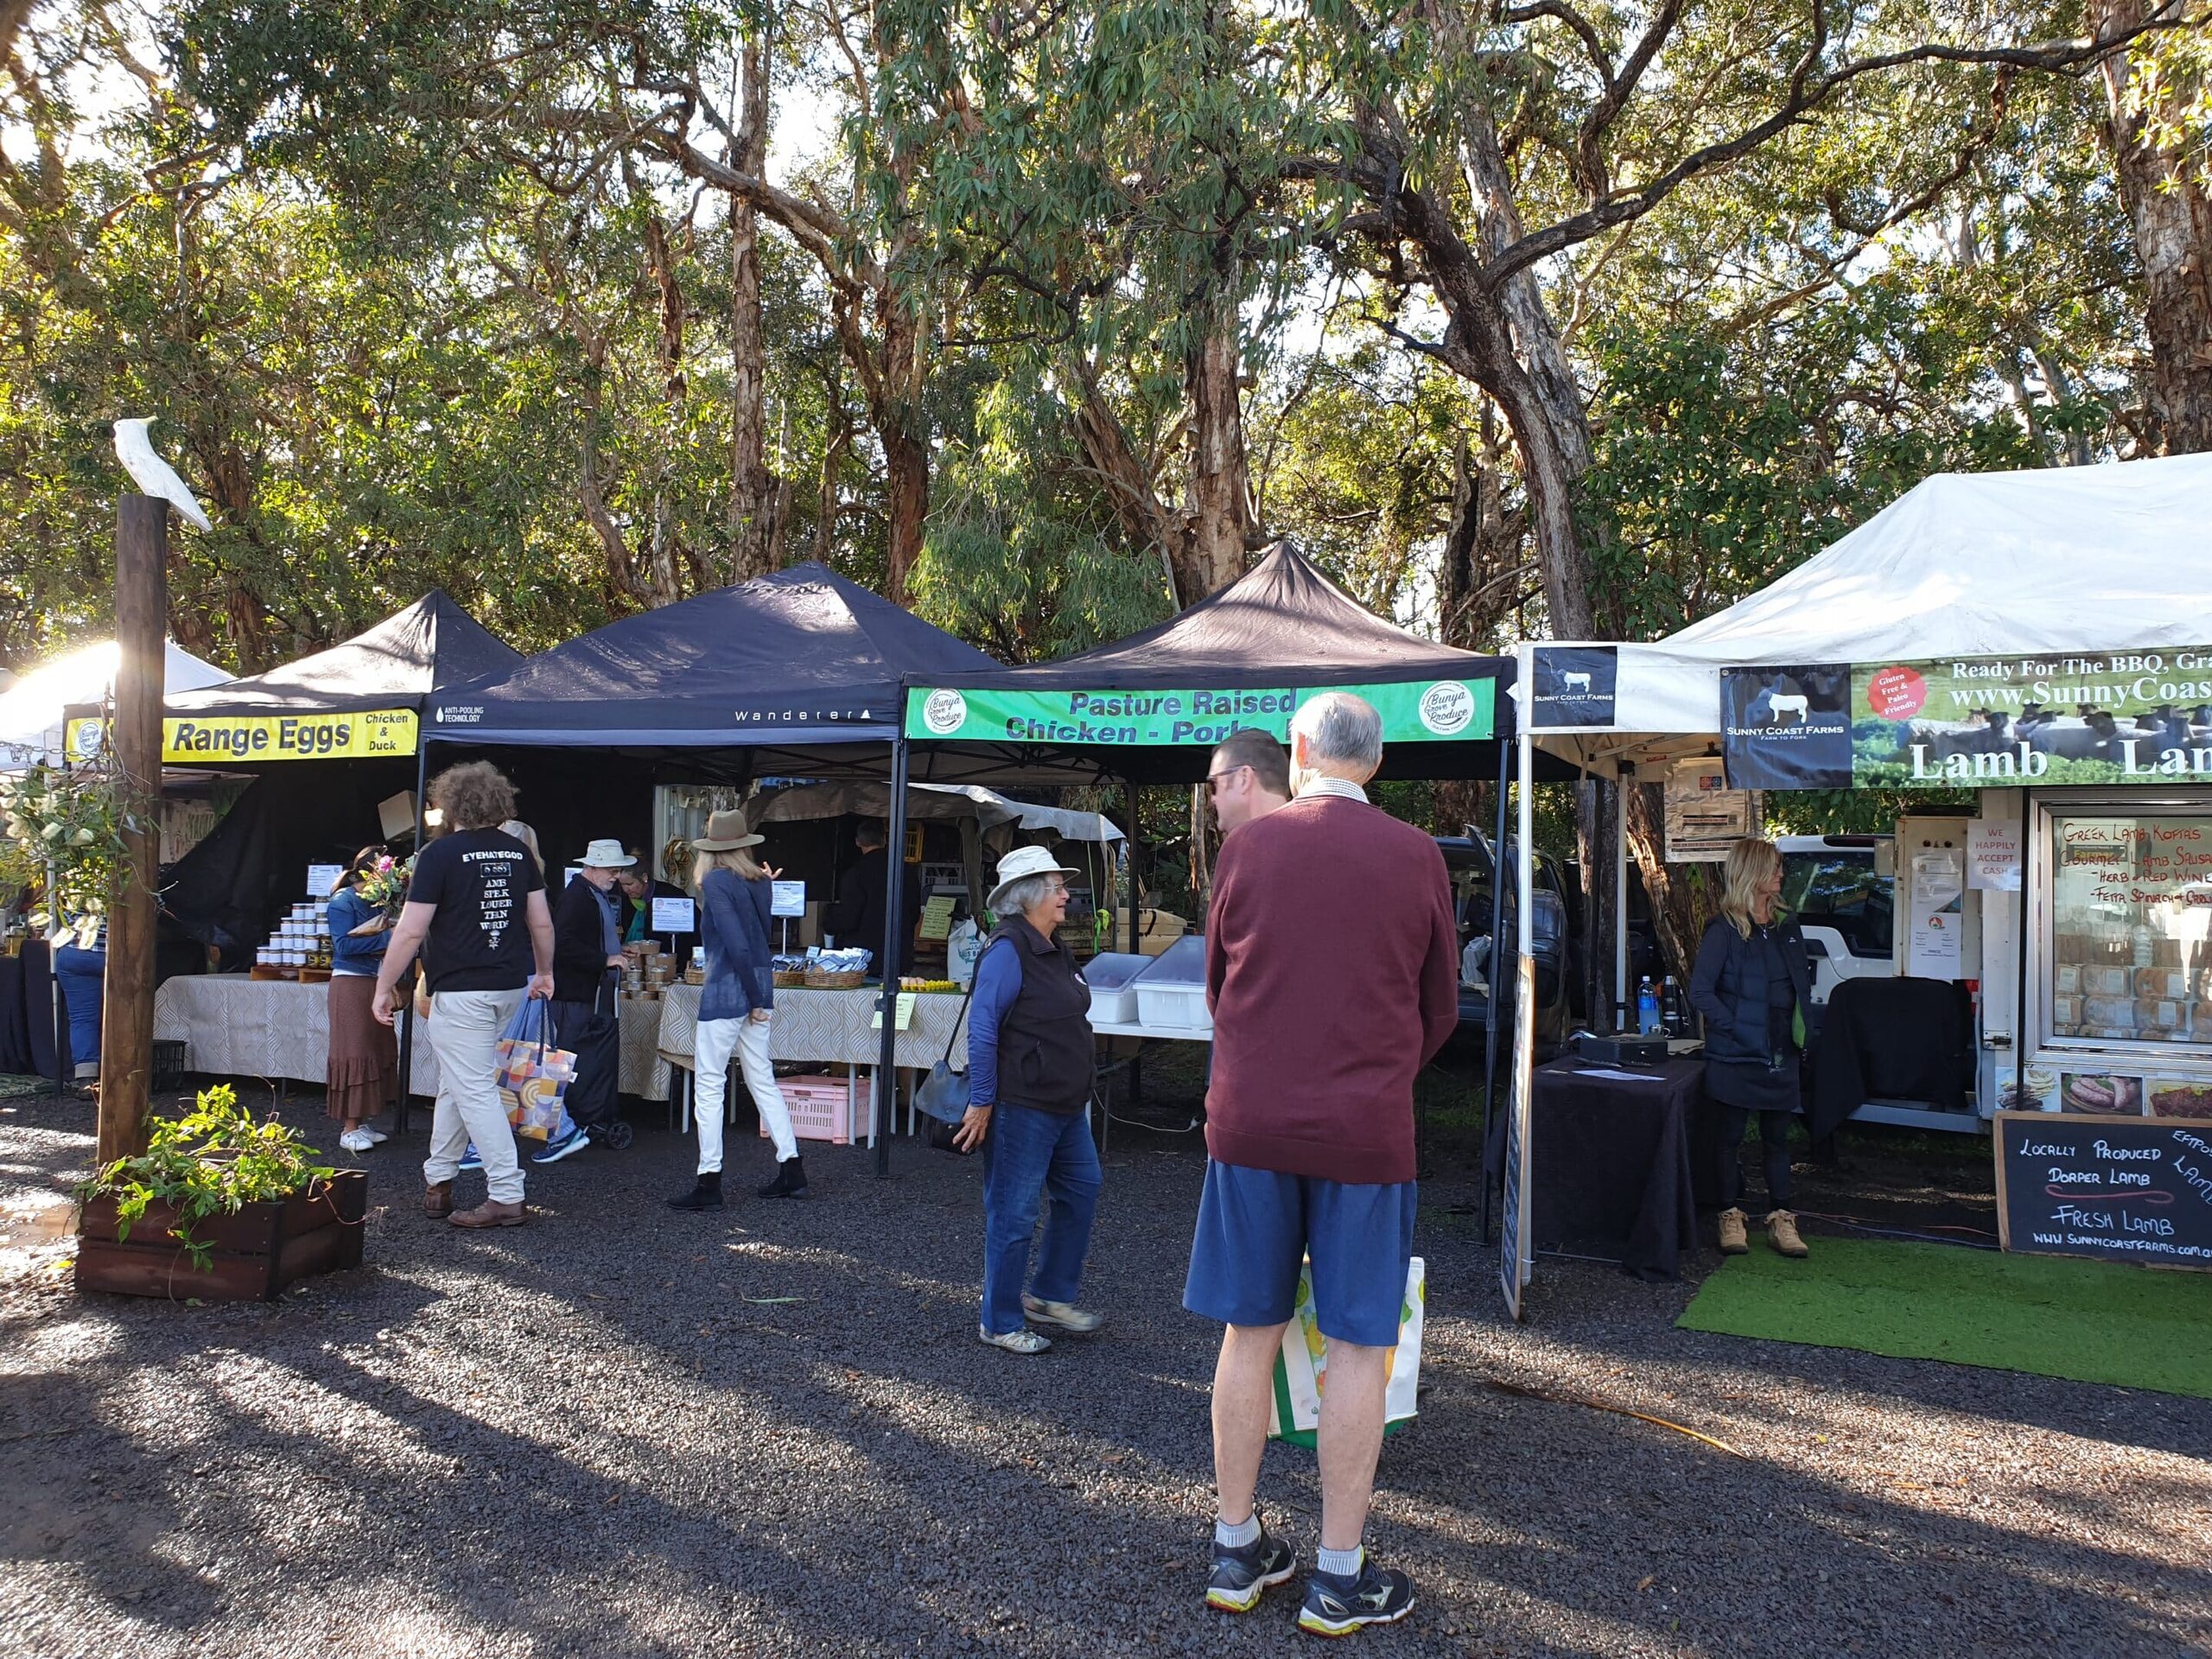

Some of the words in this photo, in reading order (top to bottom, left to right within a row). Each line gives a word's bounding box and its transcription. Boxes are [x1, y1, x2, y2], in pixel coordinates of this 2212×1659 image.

[1952, 660, 2017, 682] Ready
[2020, 659, 2057, 677] For
[2063, 658, 2104, 676] The
[2110, 654, 2170, 675] BBQ,
[1878, 673, 1905, 687] Gluten
[1881, 686, 1899, 696] Free
[1900, 682, 1908, 690] &
[932, 696, 962, 711] Bunya
[1069, 691, 1181, 717] Pasture
[1192, 688, 1296, 716] Raised
[1431, 691, 1466, 707] Bunya
[1887, 692, 1909, 704] Paleo
[444, 706, 484, 715] ANTI-POOLING
[734, 709, 853, 721] Wanderer
[1884, 701, 1916, 716] Friendly
[365, 712, 409, 725] Chicken
[444, 714, 481, 723] TECHNOLOGY
[931, 712, 962, 724] Produce
[1429, 709, 1469, 723] Produce
[1006, 716, 1137, 743] Chicken
[1726, 726, 1762, 736] SUNNY
[1765, 726, 1803, 736] COAST
[1806, 725, 1844, 734] FARMS
[173, 722, 269, 757] Range
[278, 719, 351, 754] Eggs
[368, 741, 397, 752] Duck
[1909, 741, 2049, 780] Lamb
[1987, 829, 2004, 837] WE
[2063, 823, 2108, 842] GREEK
[2113, 823, 2146, 842] LAMB
[1975, 841, 2017, 850] HAPPILY
[462, 850, 523, 862] EYEHATEGOD
[1976, 854, 2014, 862] ACCEPT
[2130, 850, 2170, 868] LAMB
[1982, 867, 2008, 875] CASH
[2143, 869, 2168, 883] RED
[2019, 1138, 2075, 1157] LOCALLY
[2093, 1140, 2161, 1161] PRODUCED
[2048, 1166, 2101, 1185] DORPER
[2109, 1167, 2151, 1186] LAMB
[2050, 1205, 2114, 1230] FRESH
[2122, 1210, 2175, 1236] LAMB
